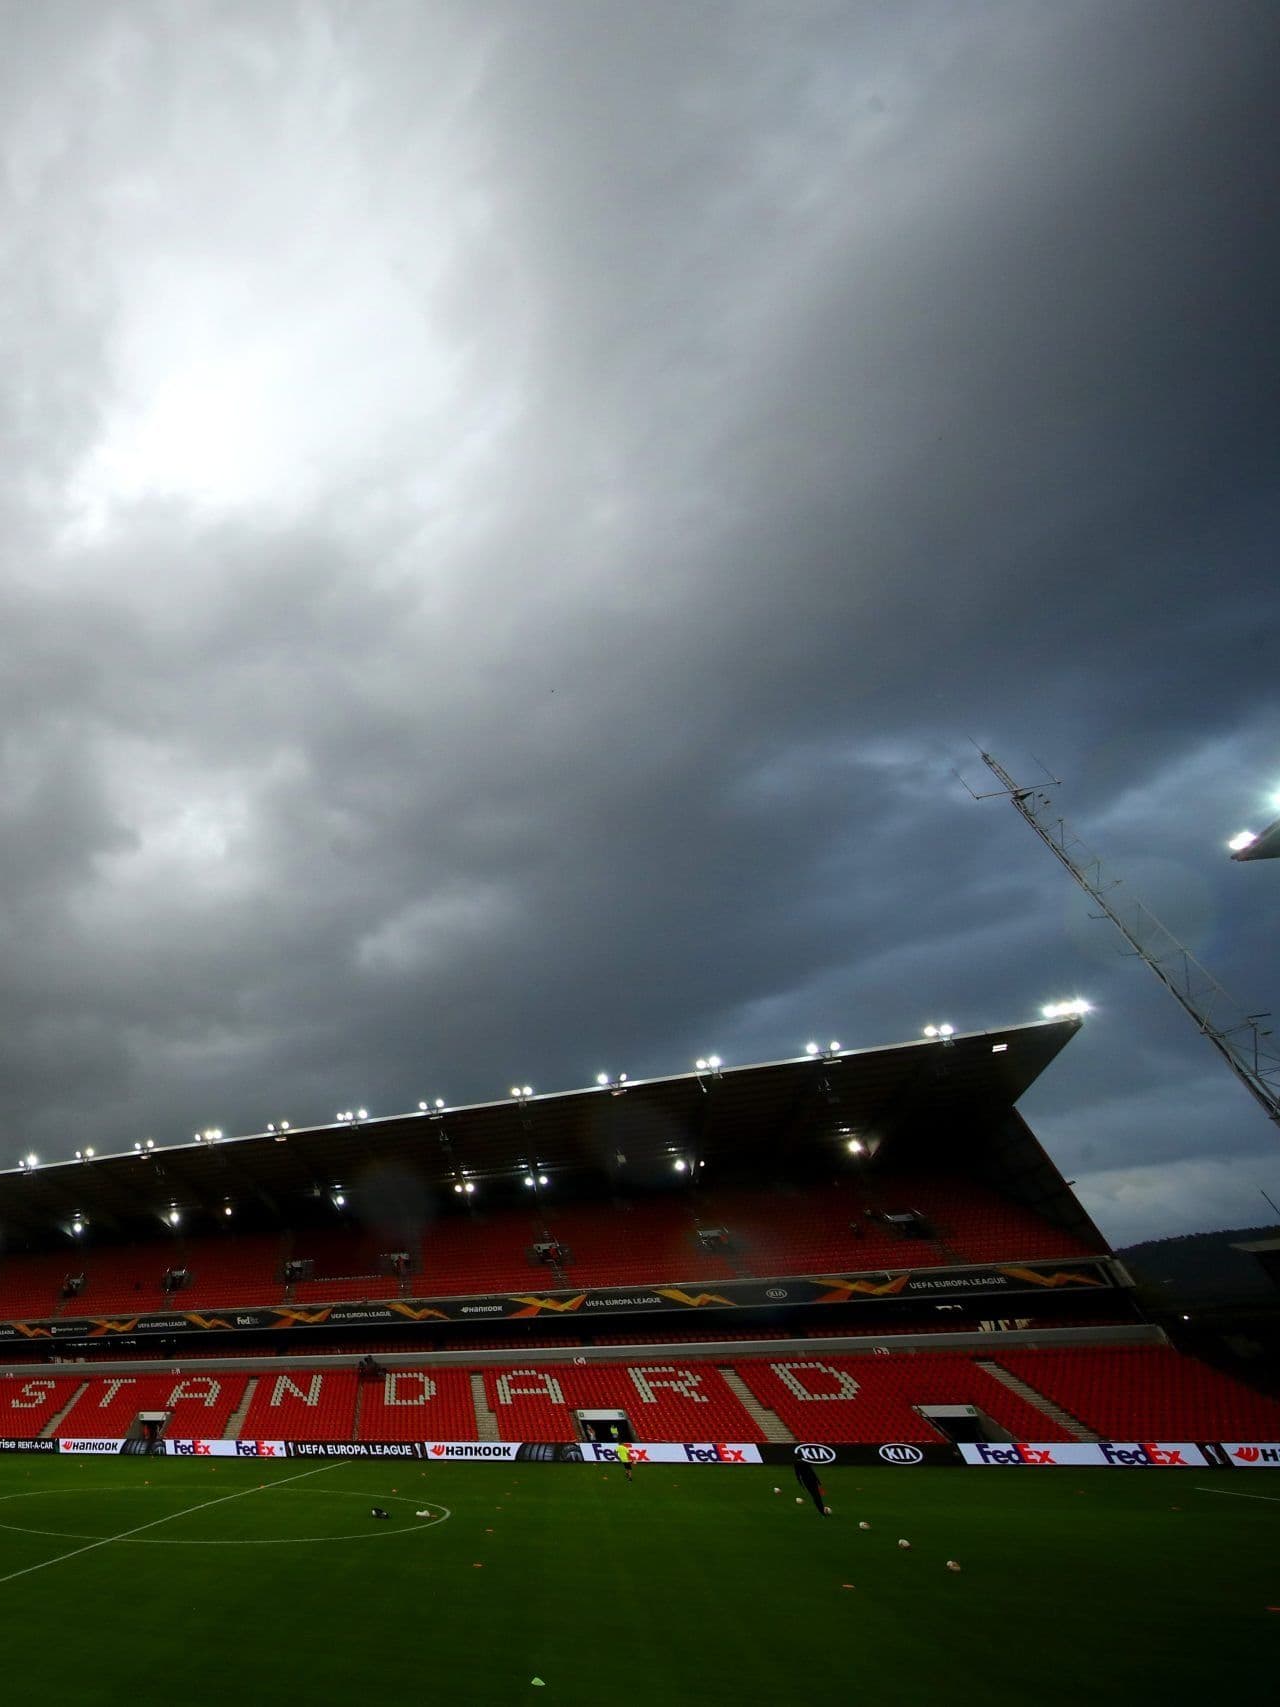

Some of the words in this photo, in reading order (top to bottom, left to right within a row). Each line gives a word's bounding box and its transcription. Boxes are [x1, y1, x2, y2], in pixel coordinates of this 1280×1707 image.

[909, 1280, 934, 1290] UEFA
[935, 1279, 970, 1288] EUROPA
[971, 1276, 1008, 1286] LEAGUE
[586, 1299, 605, 1307] UEFA
[606, 1298, 632, 1306] EUROPA
[633, 1296, 662, 1305] LEAGUE
[17, 1440, 53, 1450] RENT-A-CAR
[173, 1440, 211, 1455] FedEx
[235, 1440, 275, 1456] FedEx
[297, 1443, 325, 1455] UEFA
[327, 1444, 367, 1455] EUROPA
[369, 1444, 412, 1456] LEAGUE
[683, 1442, 746, 1462] FedEx
[800, 1446, 831, 1461] KIA
[885, 1446, 918, 1461] KIA
[976, 1443, 1057, 1464] FedEx
[1098, 1443, 1188, 1465] FedEx
